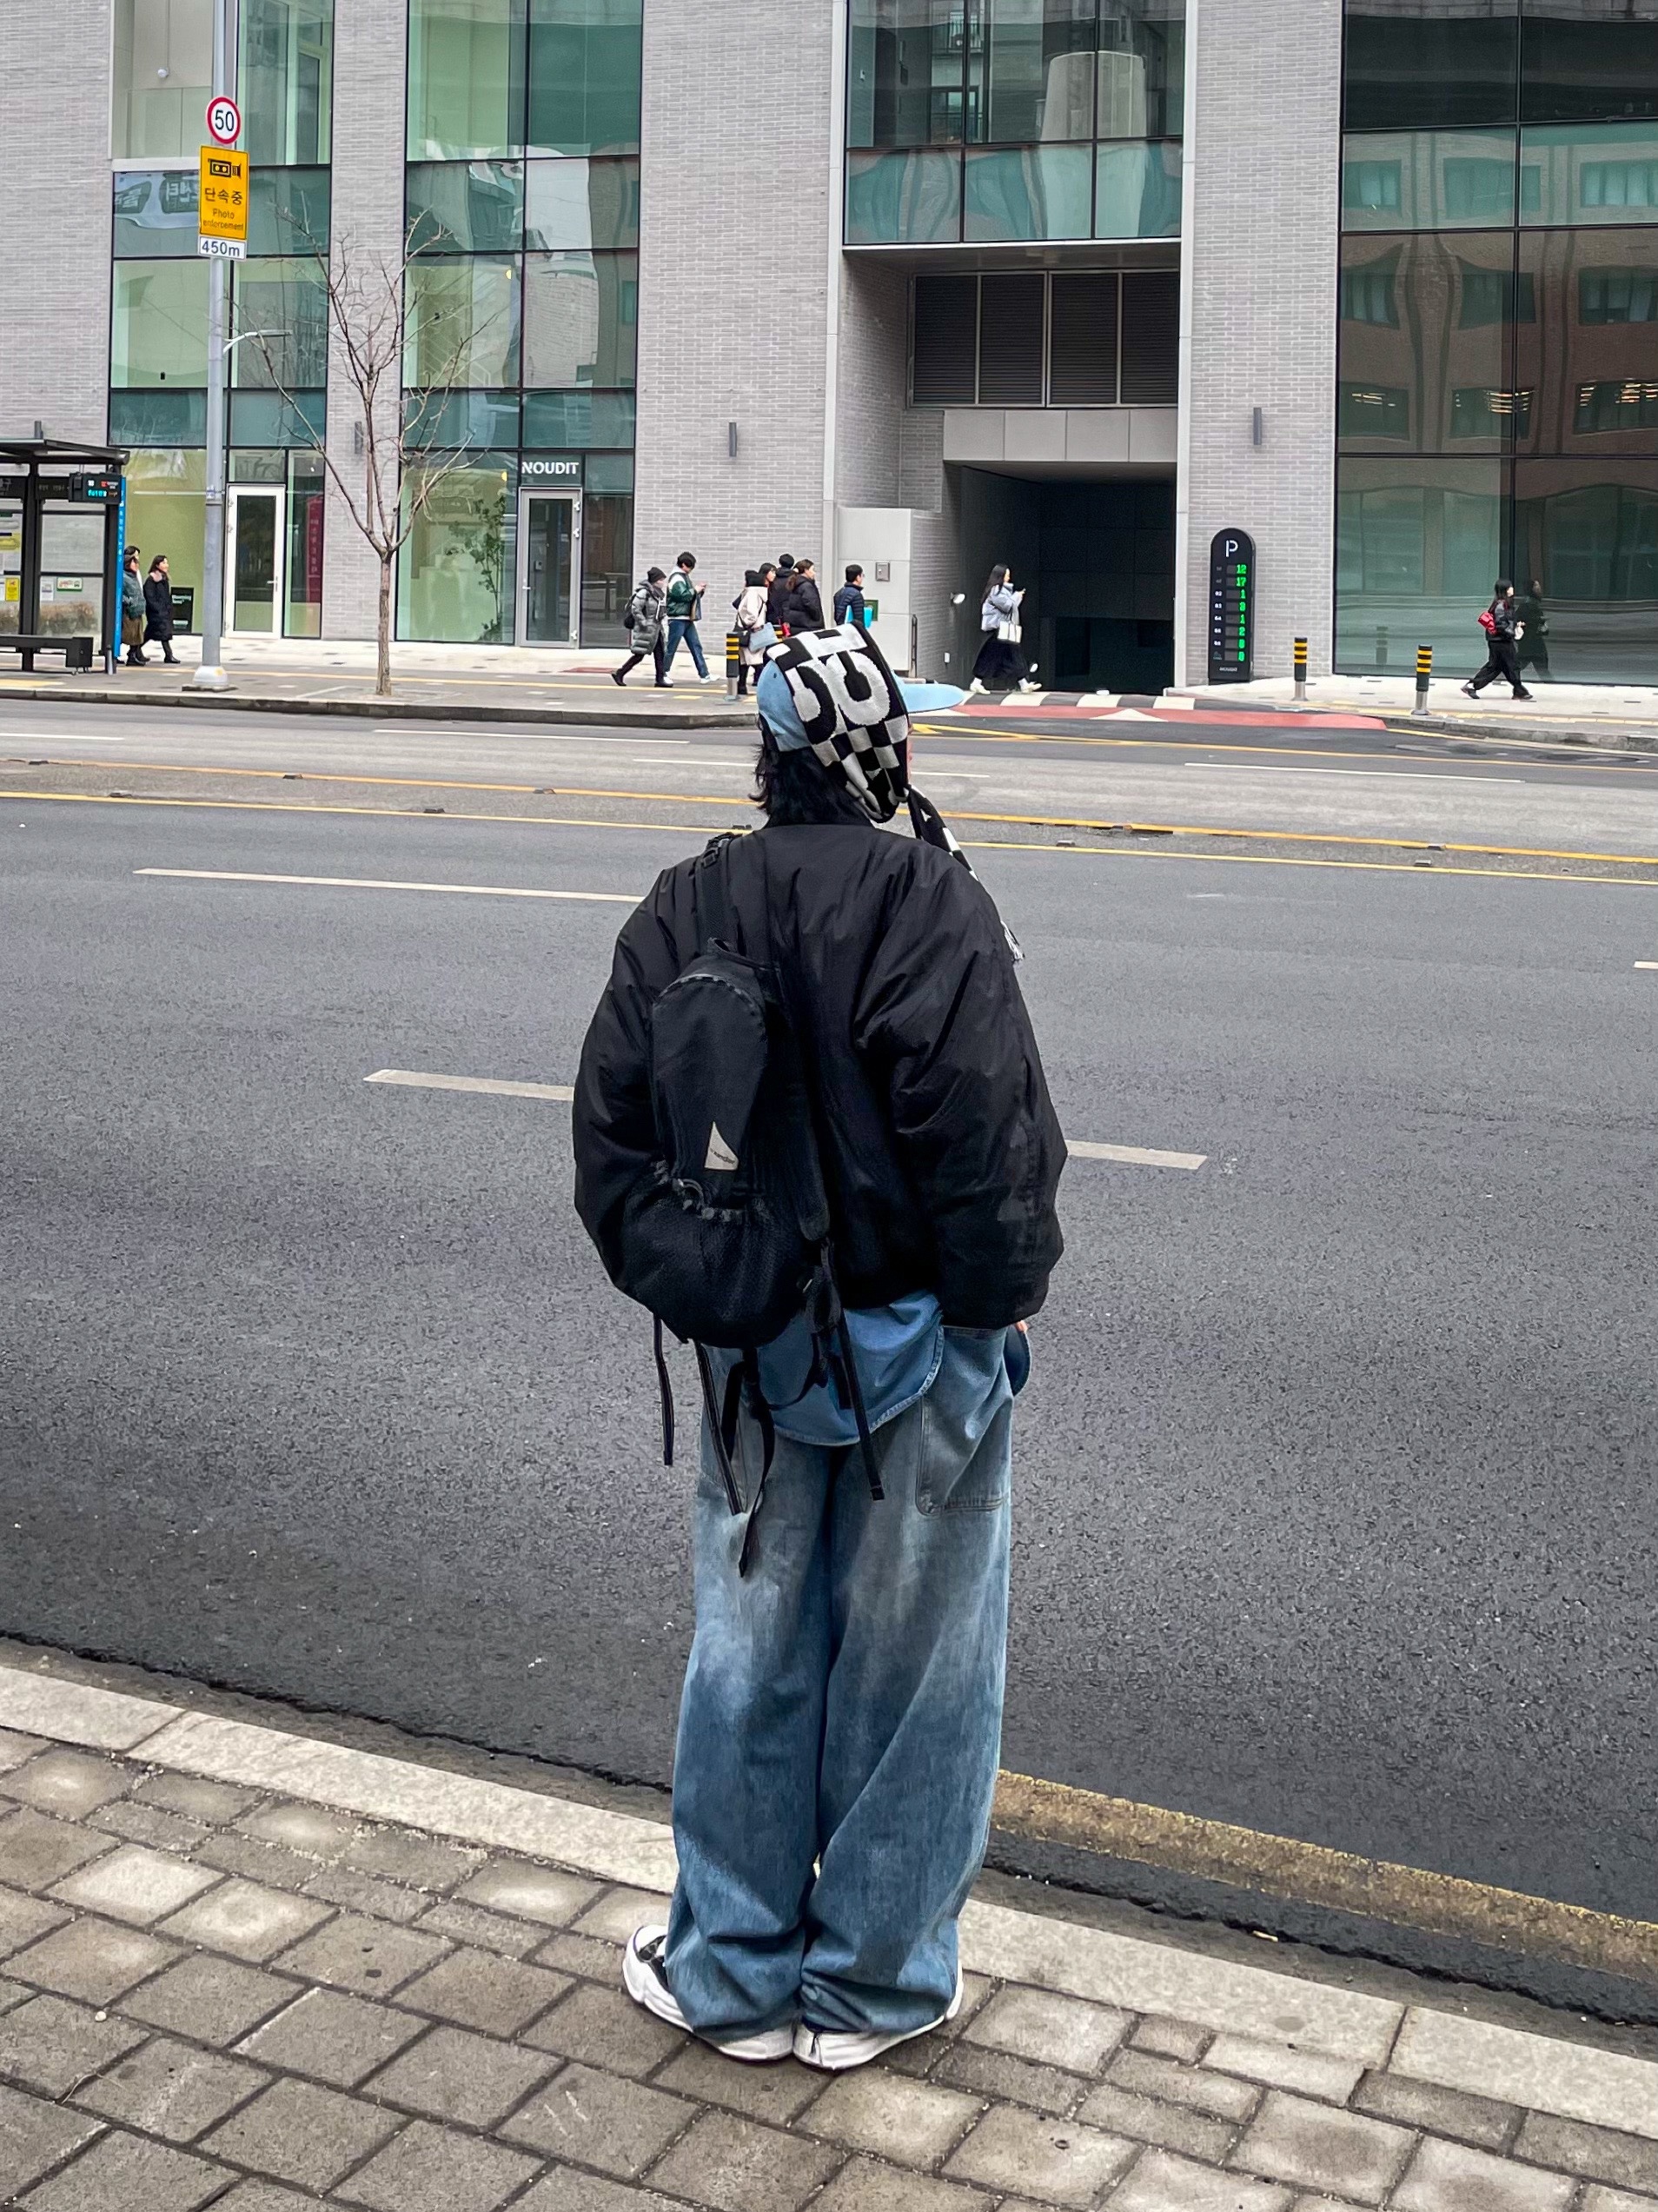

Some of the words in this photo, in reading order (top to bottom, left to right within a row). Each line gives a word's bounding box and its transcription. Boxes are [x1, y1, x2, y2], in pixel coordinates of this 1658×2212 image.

[215, 110, 235, 131] 50
[204, 187, 242, 205] 단속중
[212, 208, 235, 220] Photo
[202, 240, 240, 257] 450m
[521, 462, 580, 475] NOUDIT
[1225, 540, 1238, 557] P
[1236, 564, 1247, 575] 12
[1236, 576, 1247, 587] 17
[1240, 589, 1246, 599] 1
[1240, 614, 1245, 624] 1
[1238, 627, 1245, 636] 2
